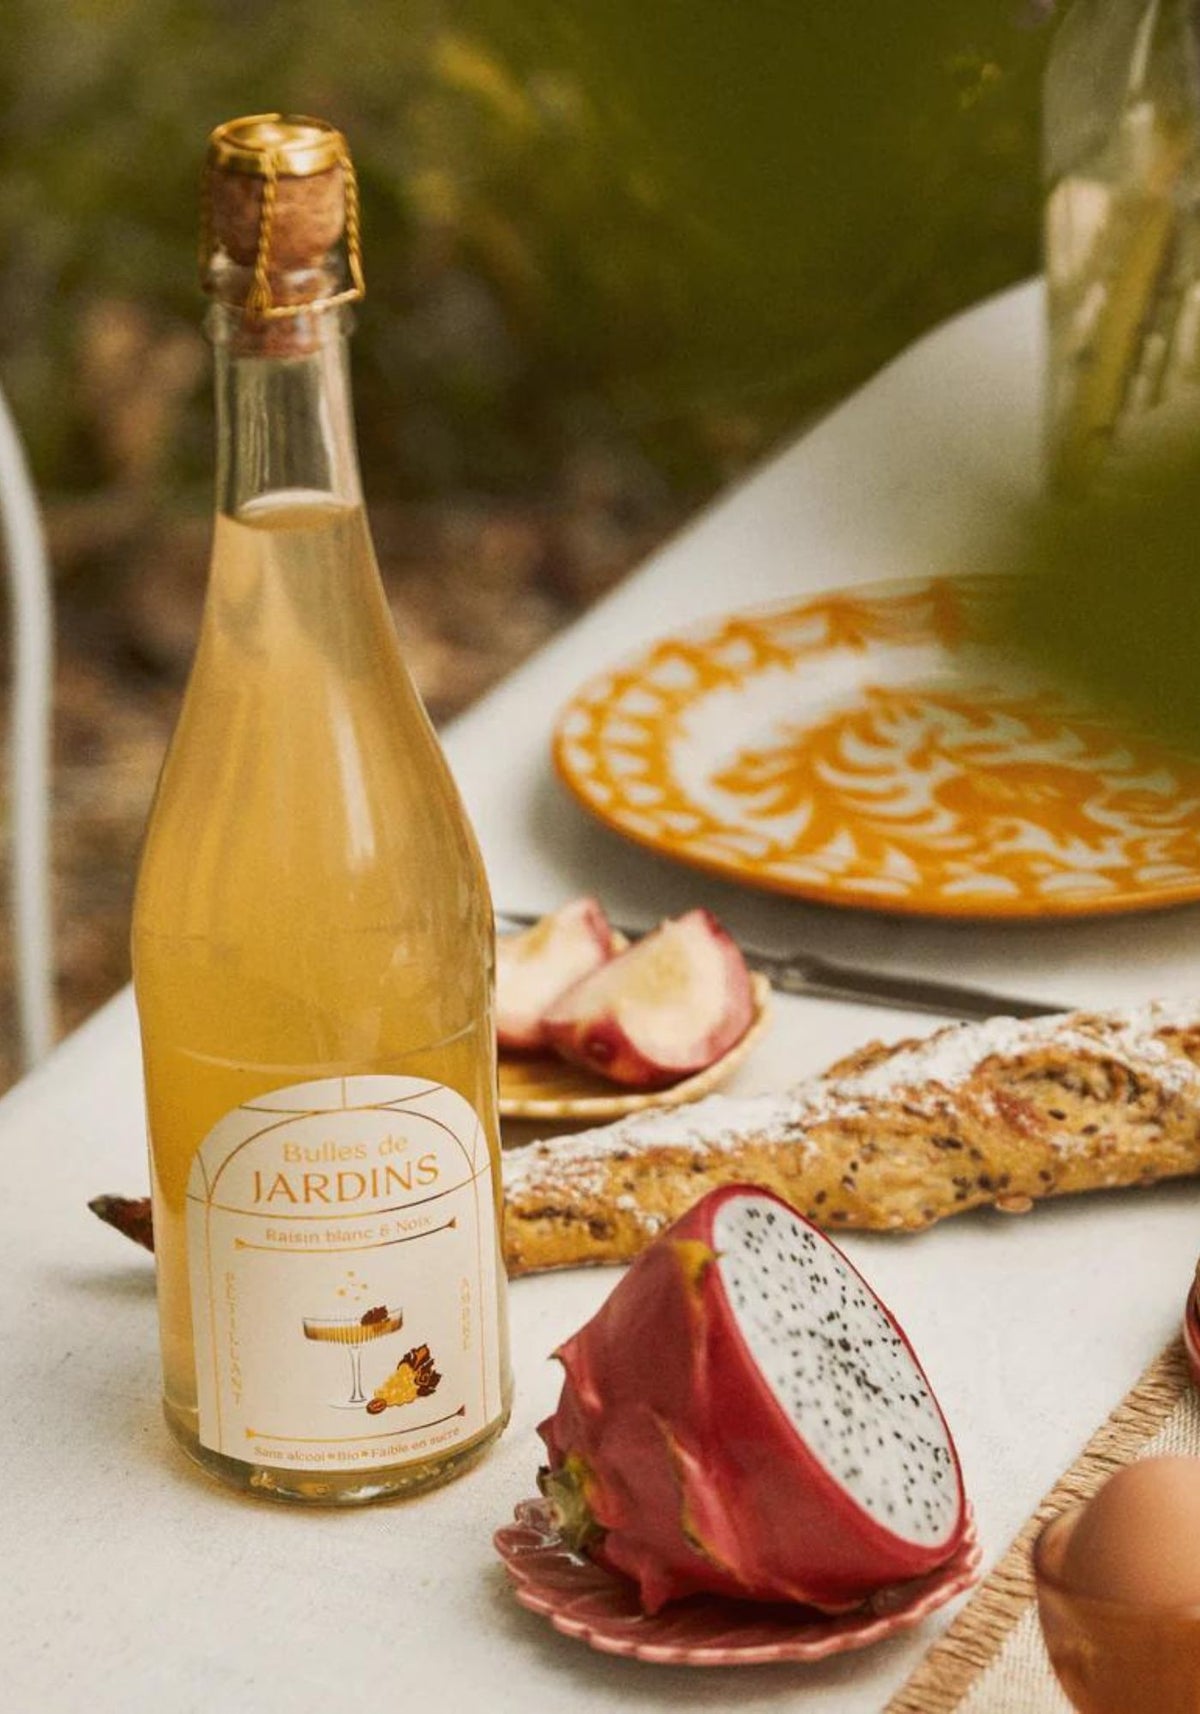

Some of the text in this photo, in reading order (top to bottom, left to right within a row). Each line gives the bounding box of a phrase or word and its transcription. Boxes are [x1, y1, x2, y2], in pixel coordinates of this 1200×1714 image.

[283, 1134, 408, 1163] Bulles de
[253, 1154, 440, 1204] JARDINS
[265, 1228, 320, 1244] Raisin
[326, 1228, 374, 1242] blanc
[396, 1214, 433, 1234] Noix
[254, 1445, 284, 1460] Sans
